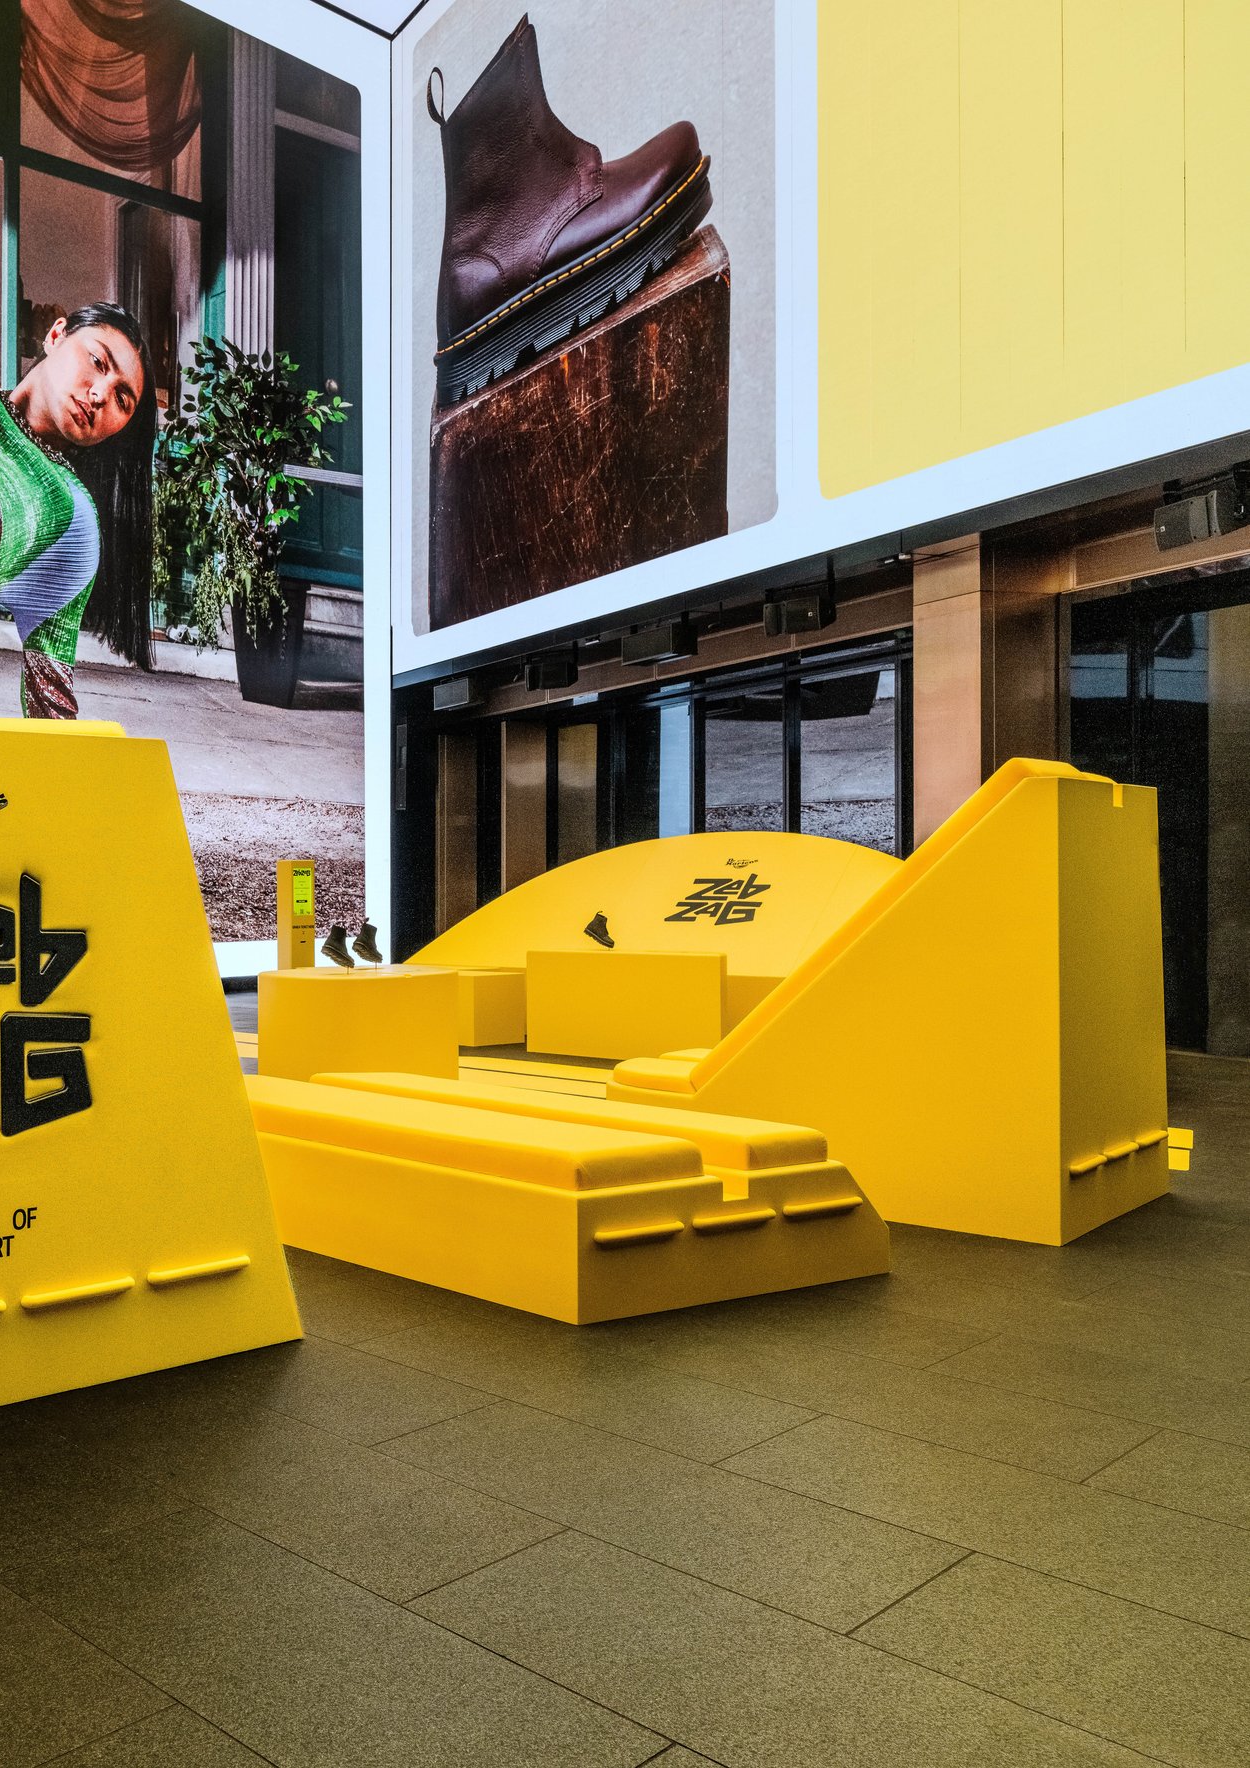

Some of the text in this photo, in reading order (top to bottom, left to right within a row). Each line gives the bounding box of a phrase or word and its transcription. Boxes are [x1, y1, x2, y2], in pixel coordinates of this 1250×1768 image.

[684, 873, 772, 901] Zeb
[663, 900, 763, 926] ZAG
[12, 1206, 38, 1231] OF
